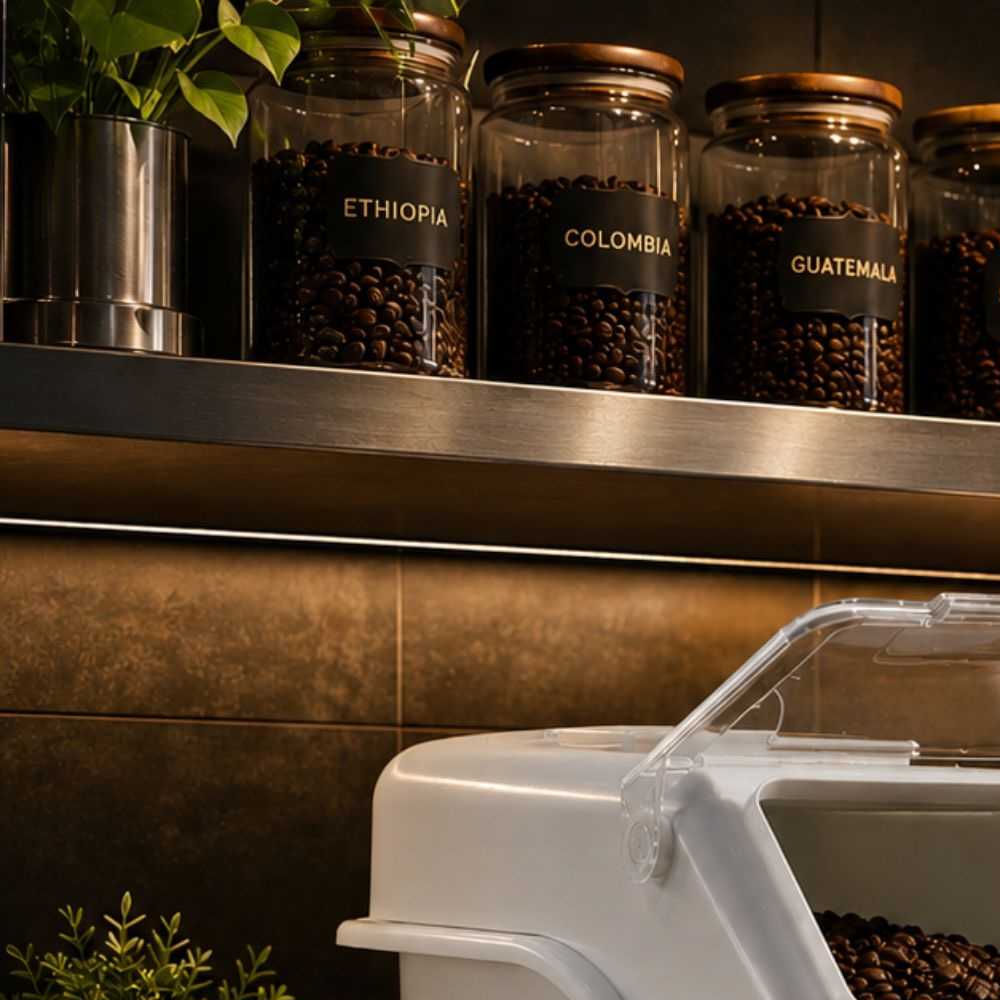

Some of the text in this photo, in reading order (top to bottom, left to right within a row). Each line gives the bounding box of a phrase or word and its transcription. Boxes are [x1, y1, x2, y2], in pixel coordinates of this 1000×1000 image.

[343, 196, 449, 229] ETHIOPIA
[563, 227, 672, 257] COLOMBIA
[790, 254, 897, 284] GUATEMALA
